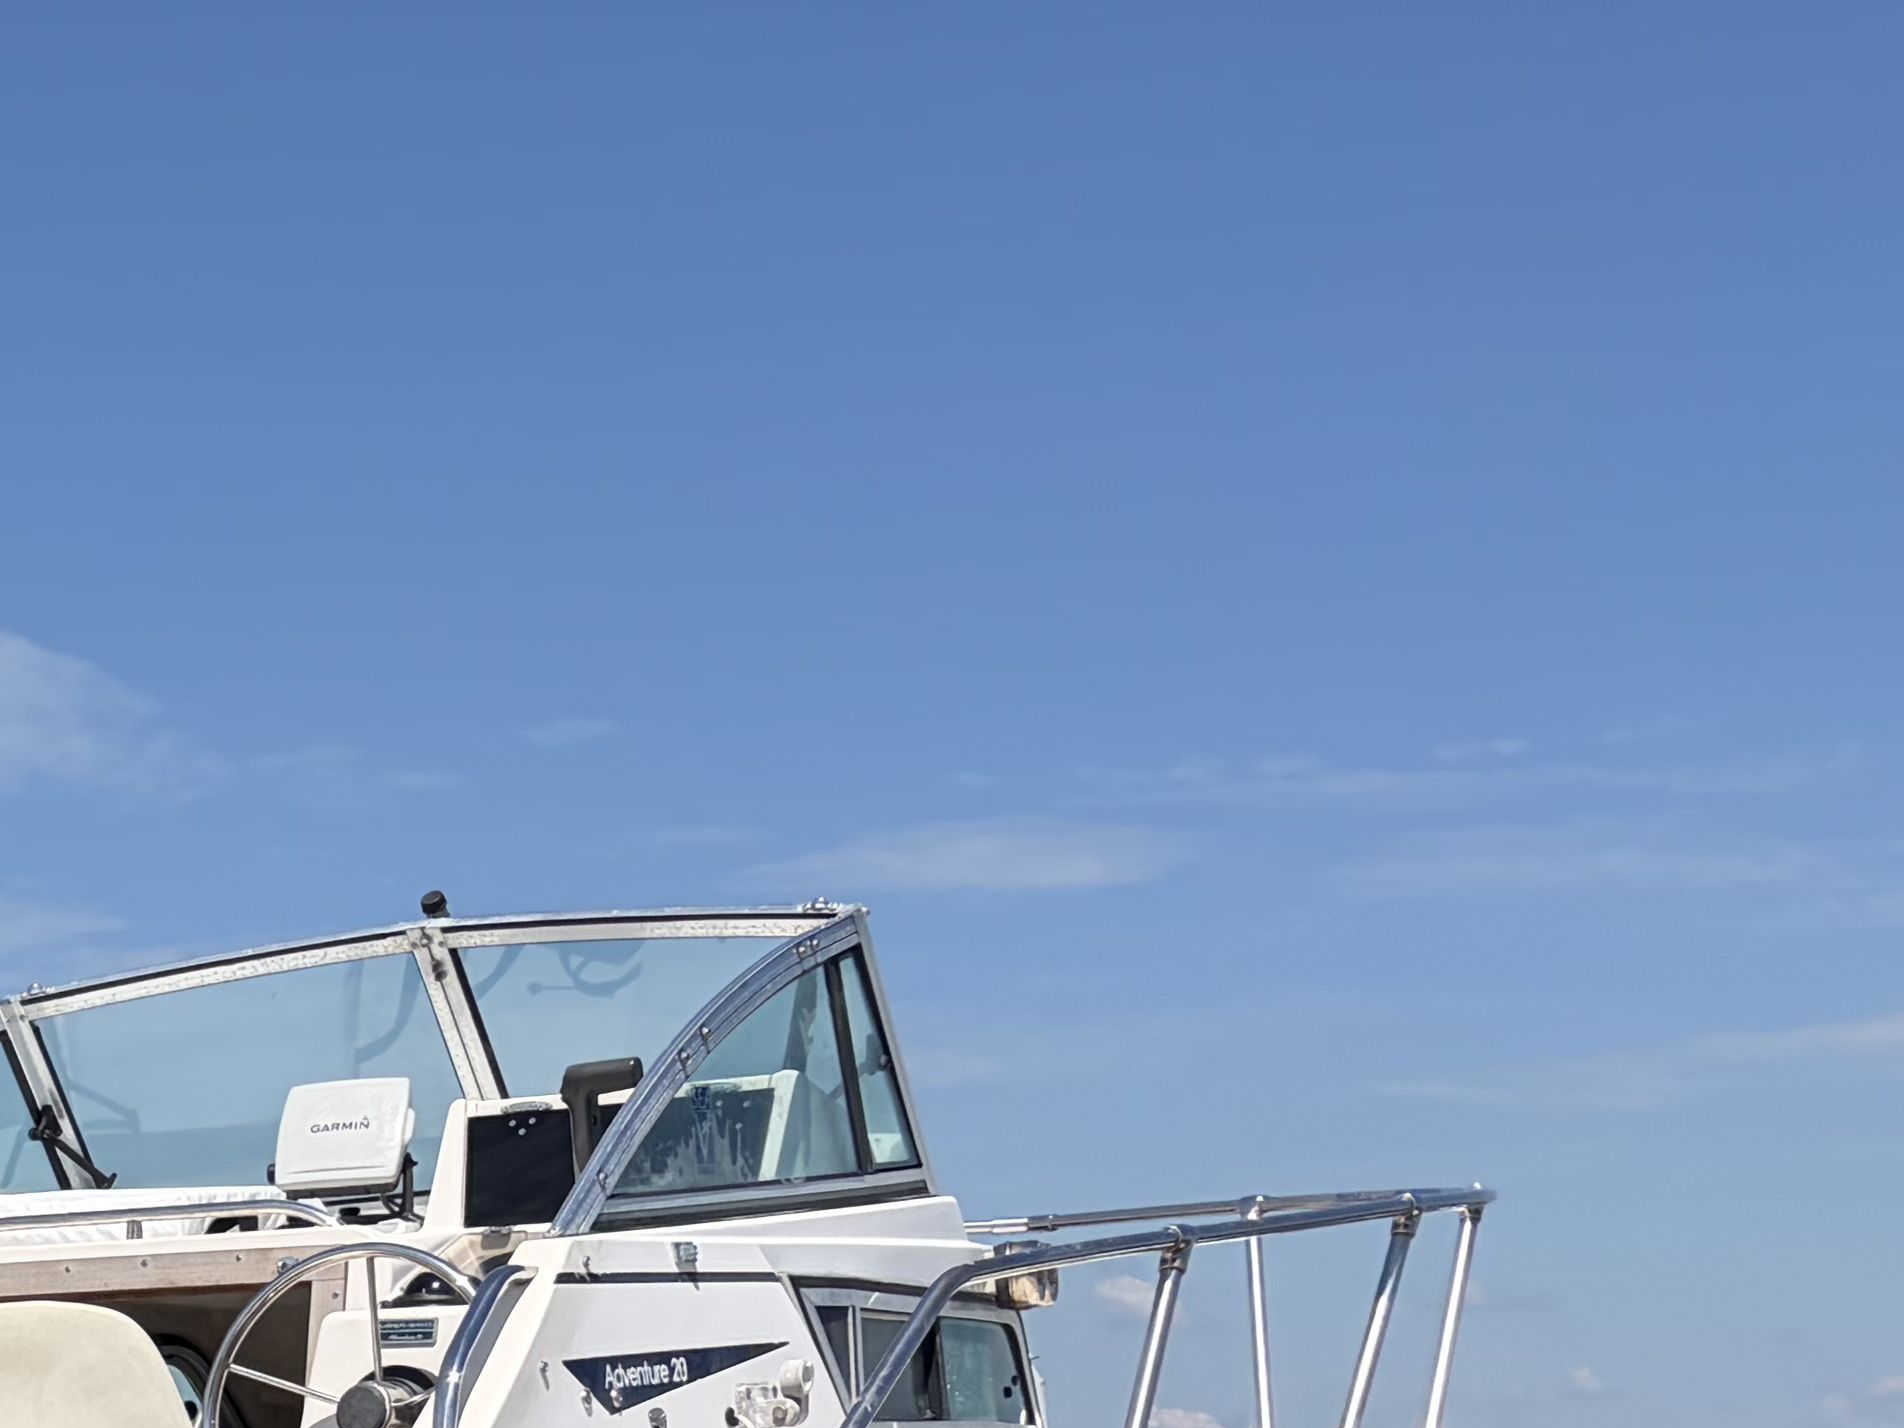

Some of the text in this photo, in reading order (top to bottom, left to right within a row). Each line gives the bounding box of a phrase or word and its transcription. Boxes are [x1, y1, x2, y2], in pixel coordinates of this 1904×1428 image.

[310, 1119, 370, 1133] GARMIN
[604, 1356, 688, 1390] Adventure 20
